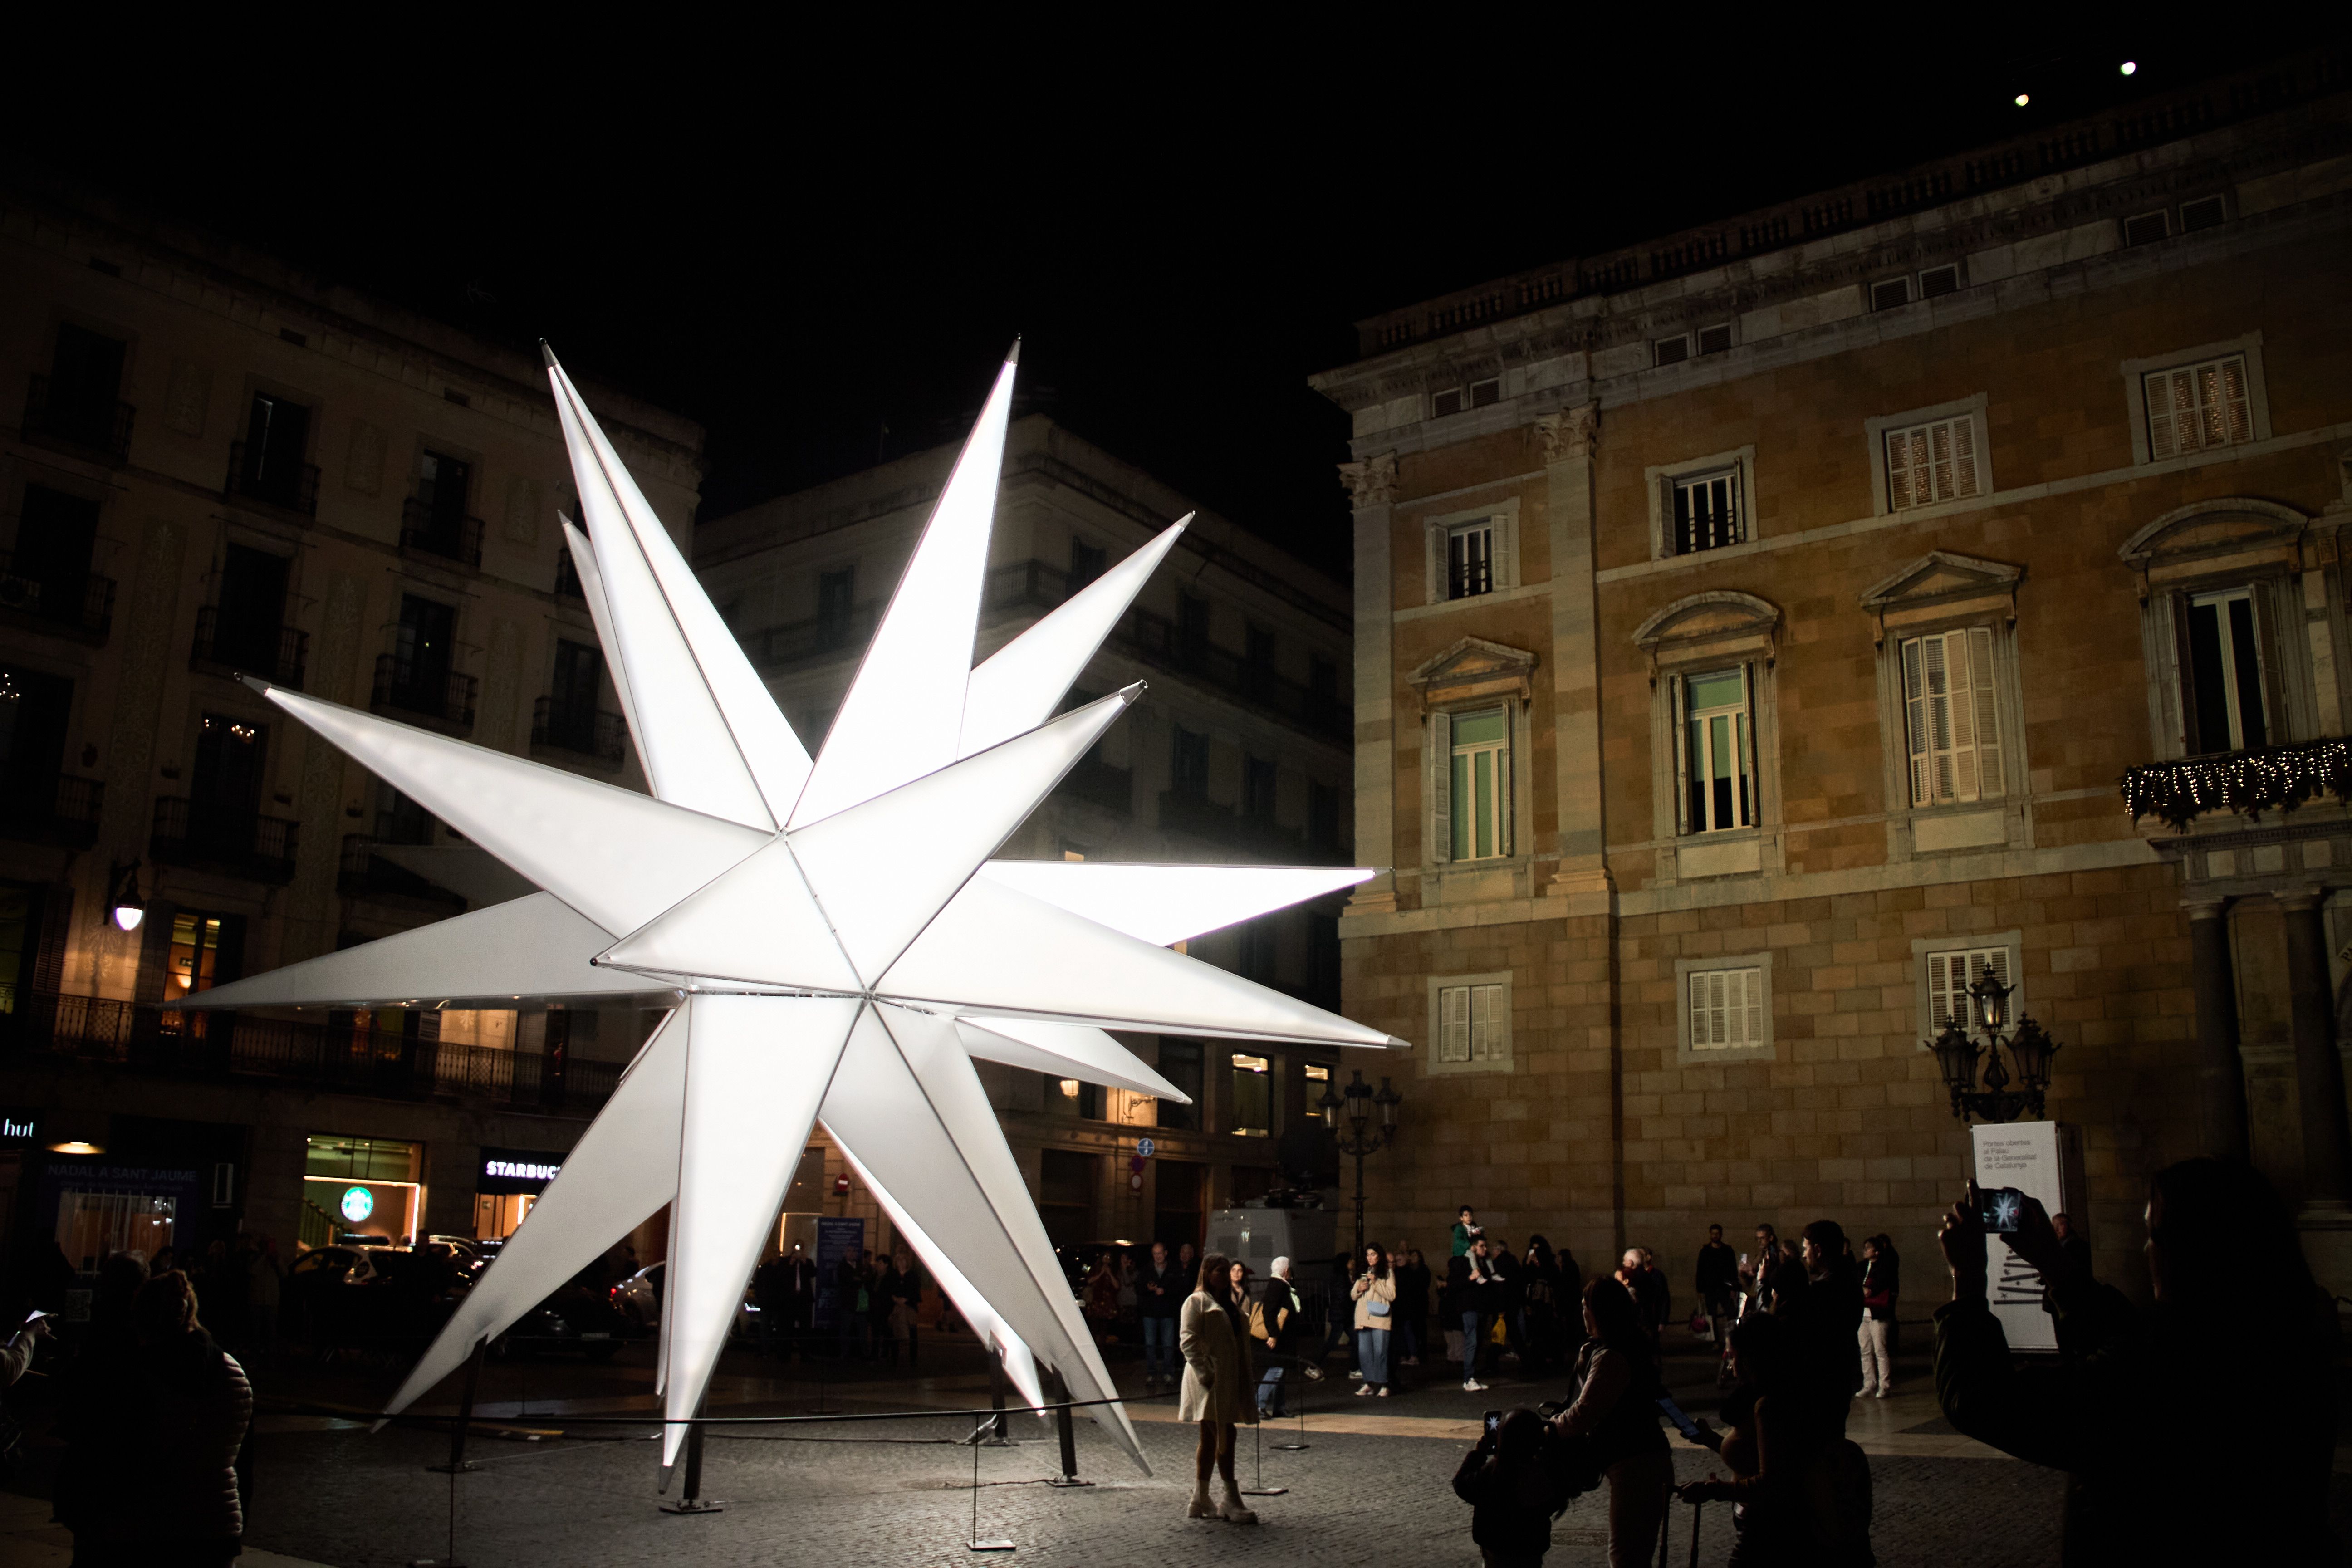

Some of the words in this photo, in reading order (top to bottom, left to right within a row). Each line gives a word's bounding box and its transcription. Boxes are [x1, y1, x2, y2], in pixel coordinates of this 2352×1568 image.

[48, 1164, 95, 1177] NADAL
[98, 1166, 108, 1178] A
[112, 1167, 148, 1179] SANT
[151, 1169, 197, 1181] JAUME
[486, 1161, 561, 1180] STARBUC
